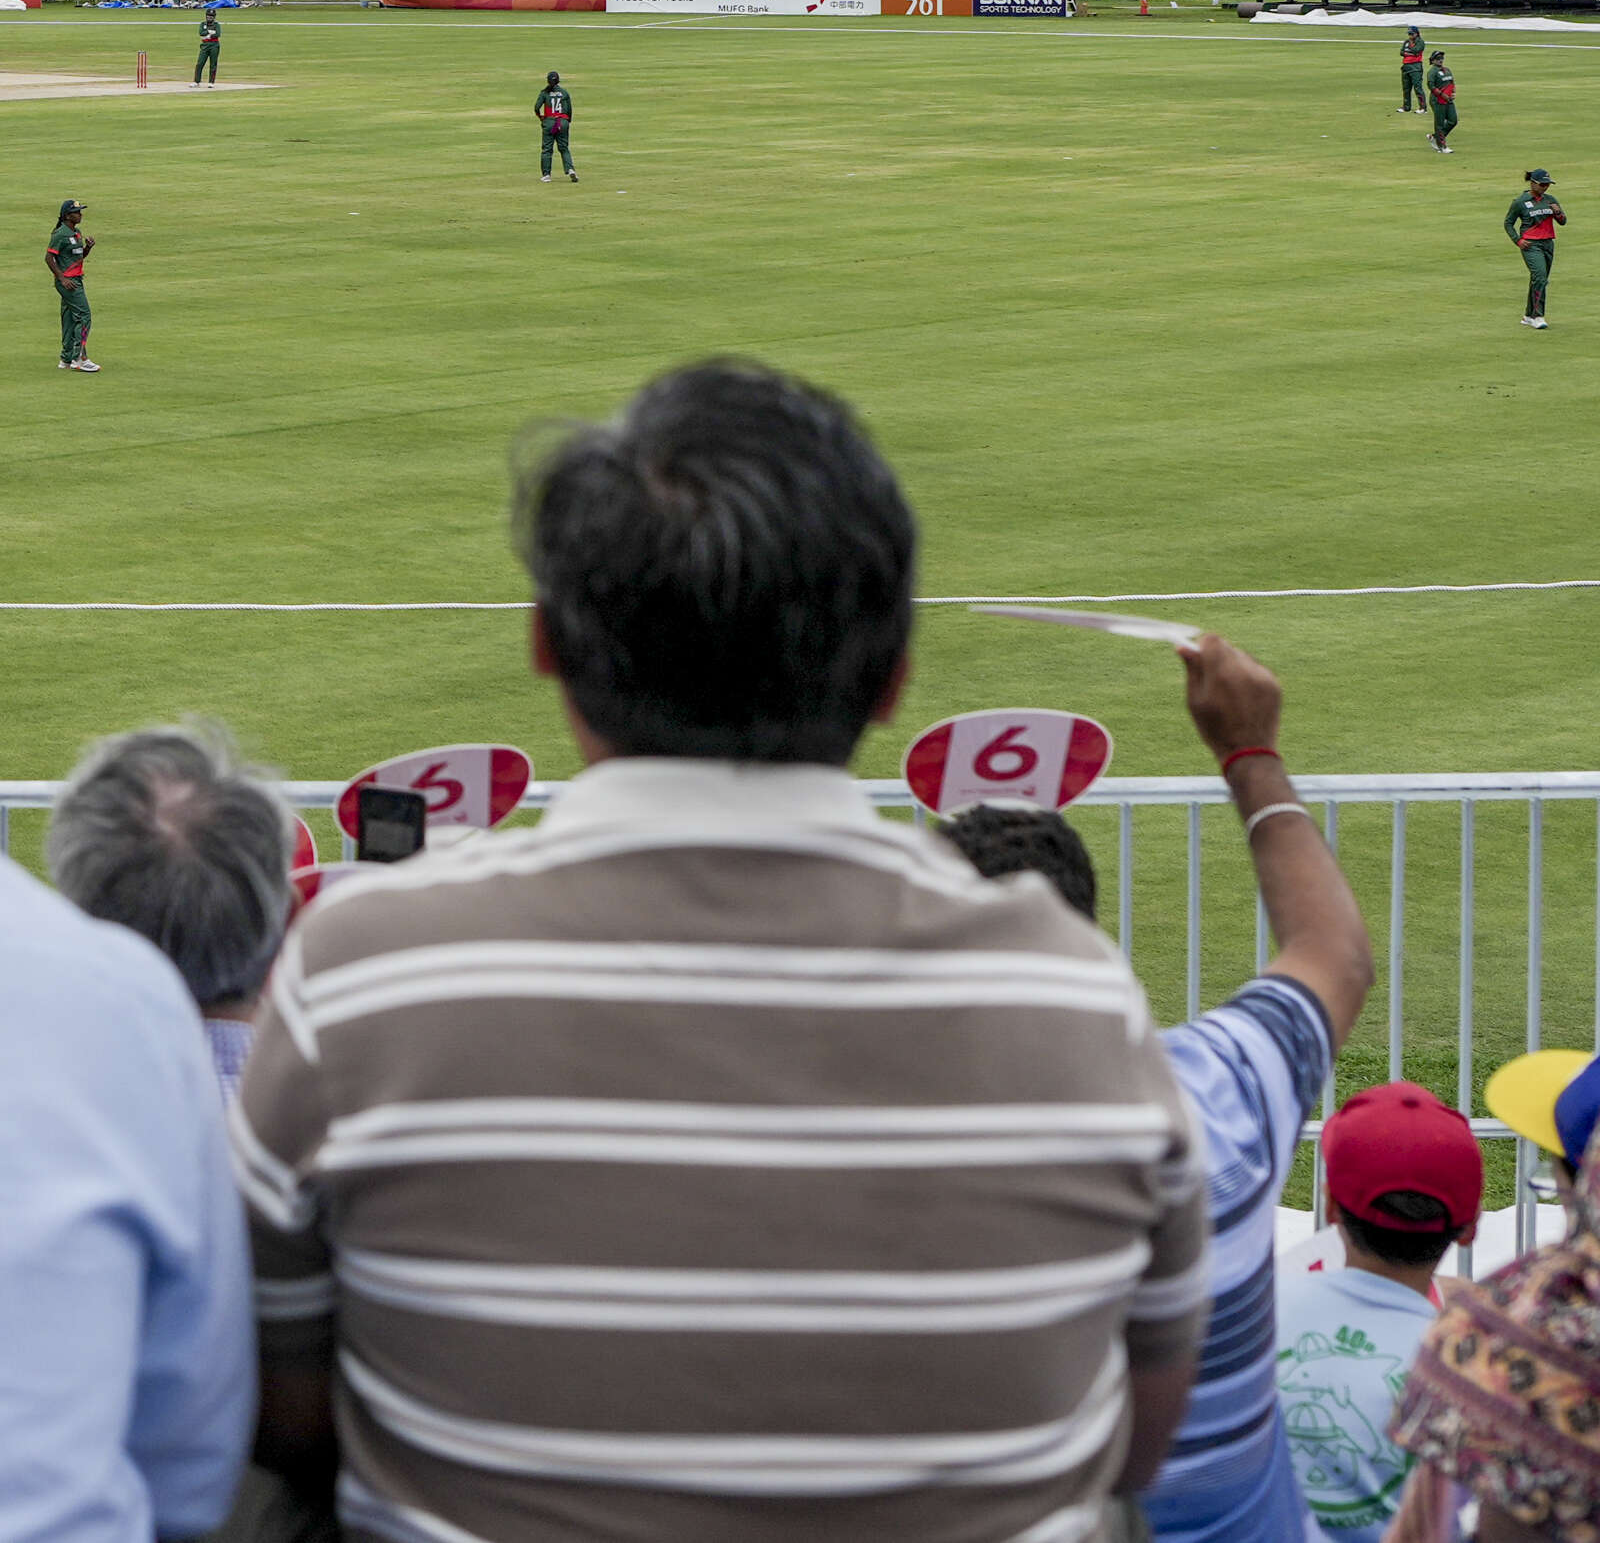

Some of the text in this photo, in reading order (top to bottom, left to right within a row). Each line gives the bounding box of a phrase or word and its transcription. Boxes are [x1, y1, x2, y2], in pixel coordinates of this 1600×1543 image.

[718, 5, 769, 13] MUFG Bank
[979, 5, 1062, 14] SPORTS TECHNOLOGY
[550, 97, 563, 114] 14
[972, 725, 1040, 782] 6
